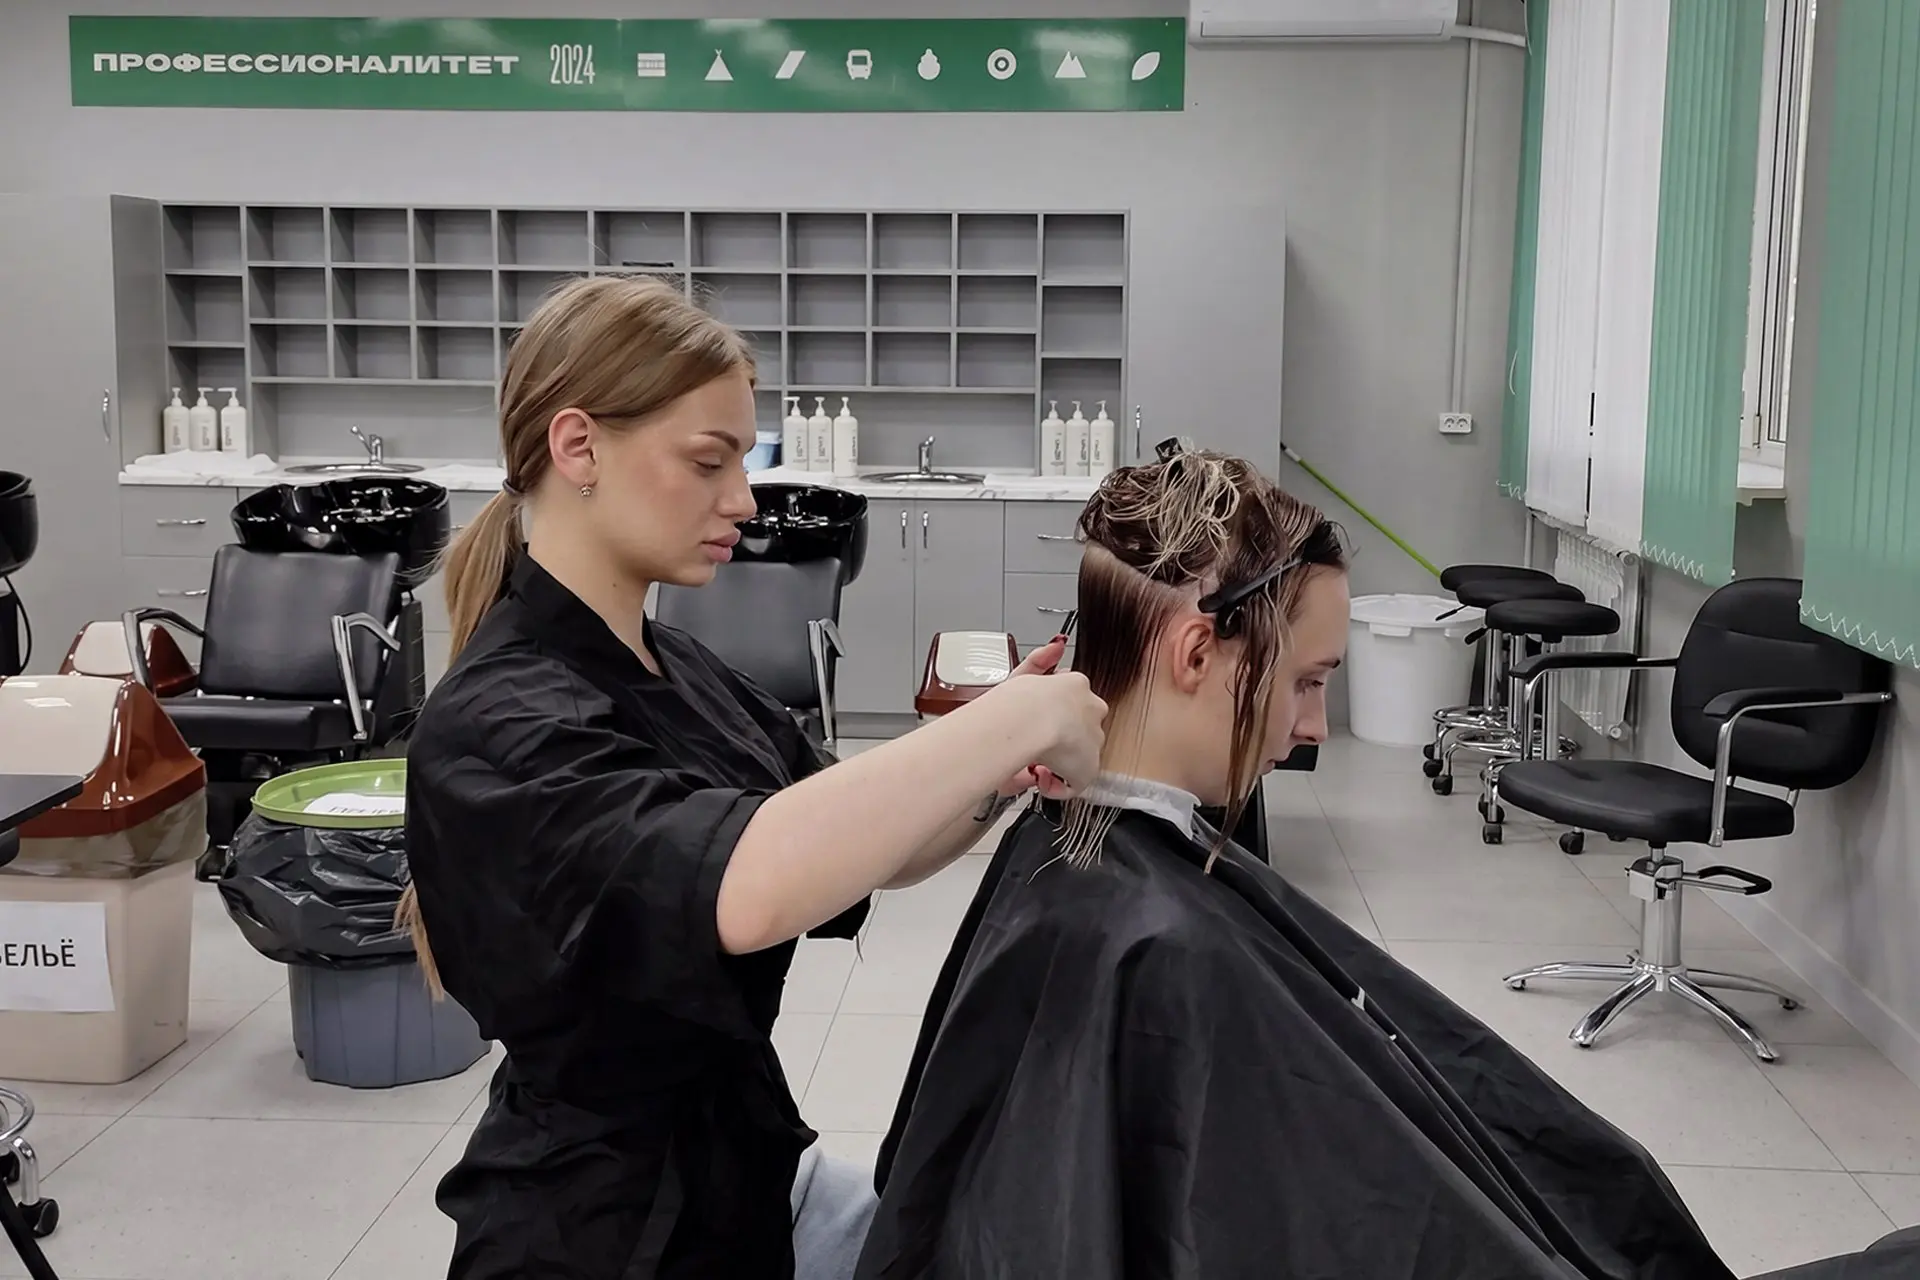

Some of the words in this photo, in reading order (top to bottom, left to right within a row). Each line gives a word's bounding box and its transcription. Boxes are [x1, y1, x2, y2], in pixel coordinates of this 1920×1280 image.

[93, 52, 520, 76] ПРОФЕССИОНАЛИТЕТ
[550, 44, 596, 85] 2024
[0, 938, 76, 968] ЕЛЬЁ
